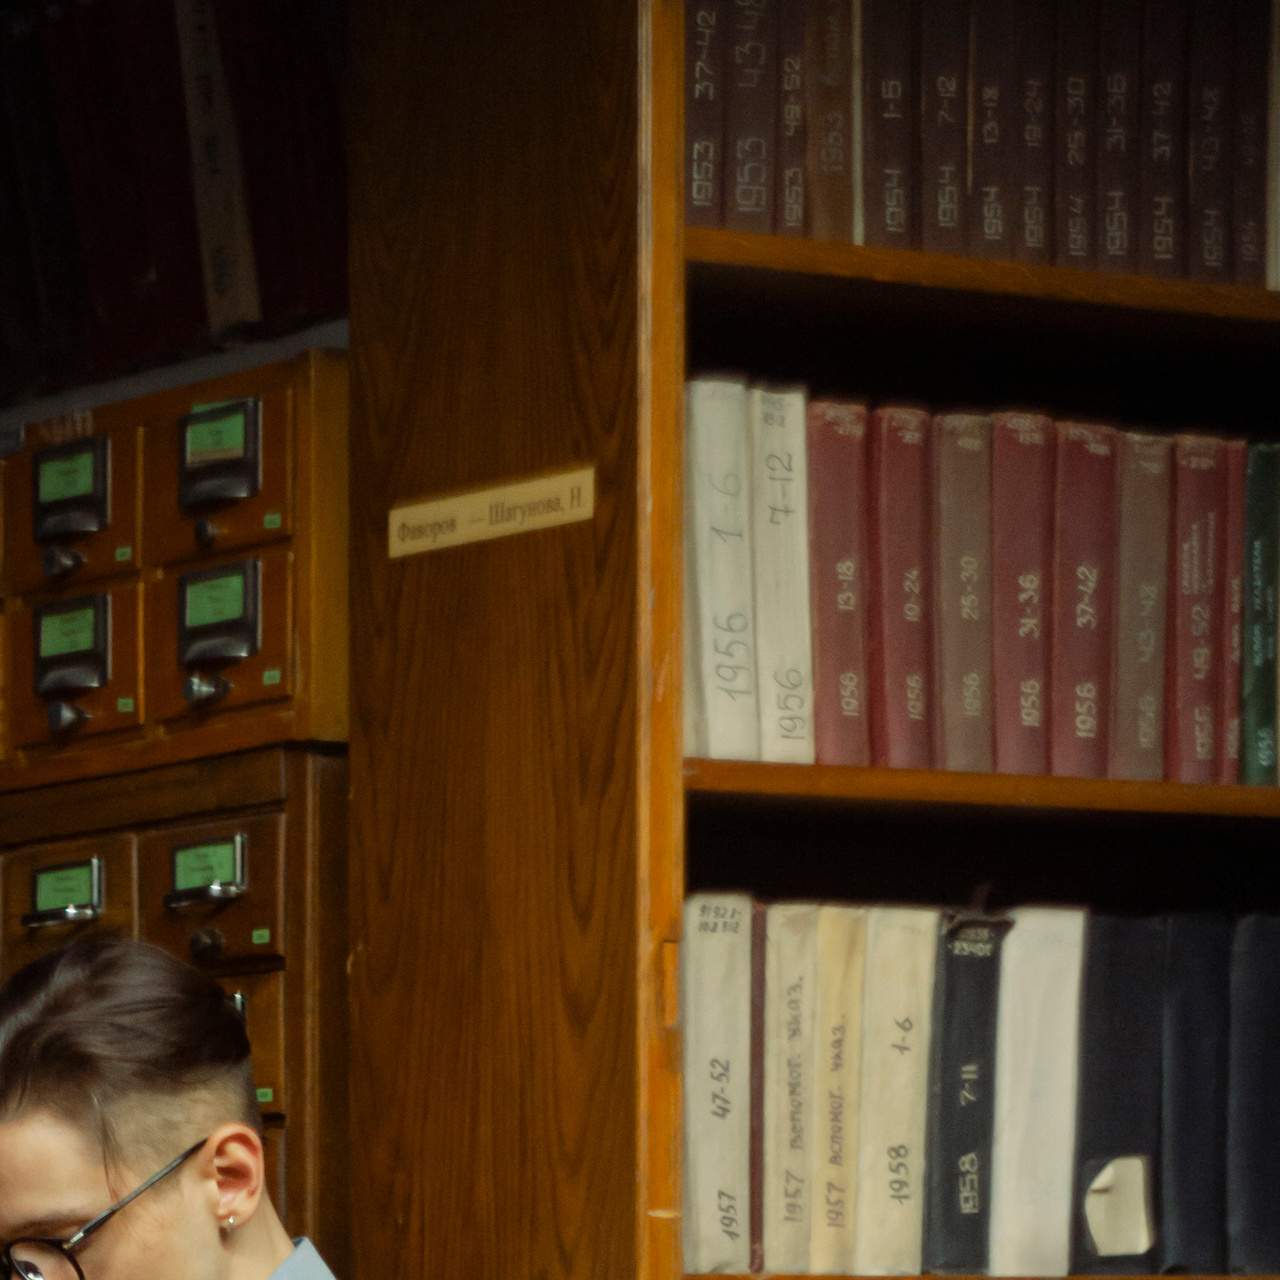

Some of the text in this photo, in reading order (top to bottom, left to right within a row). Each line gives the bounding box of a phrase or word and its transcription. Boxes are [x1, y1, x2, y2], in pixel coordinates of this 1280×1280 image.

[691, 10, 718, 206] 1953 37-42
[735, 136, 767, 213] 1953
[782, 56, 803, 227] 1953 49-52
[880, 79, 906, 233] 1954 1-6
[935, 71, 959, 228] 1954 7-12
[980, 84, 1004, 240] 1954 13-18
[1022, 78, 1045, 248] 1954 19-24
[1065, 75, 1087, 257] 1954 25-30
[1104, 72, 1128, 256] 1954 31-36
[1150, 82, 1175, 260] 1954 37-42
[764, 452, 795, 526] 7-12
[712, 611, 752, 702] 1956
[835, 558, 860, 717] 1956 13-18
[959, 554, 981, 621] 25-30
[1017, 571, 1042, 727] 1956 31-36
[1073, 564, 1099, 739] 1956 37-42
[773, 668, 806, 739] 1956
[708, 1056, 741, 1241] 1957 47-52
[886, 1016, 914, 1206] 1958 1-6
[957, 1062, 981, 1215] 1958 7-11
[783, 1168, 805, 1223] 1957
[825, 1180, 846, 1229] 1957
